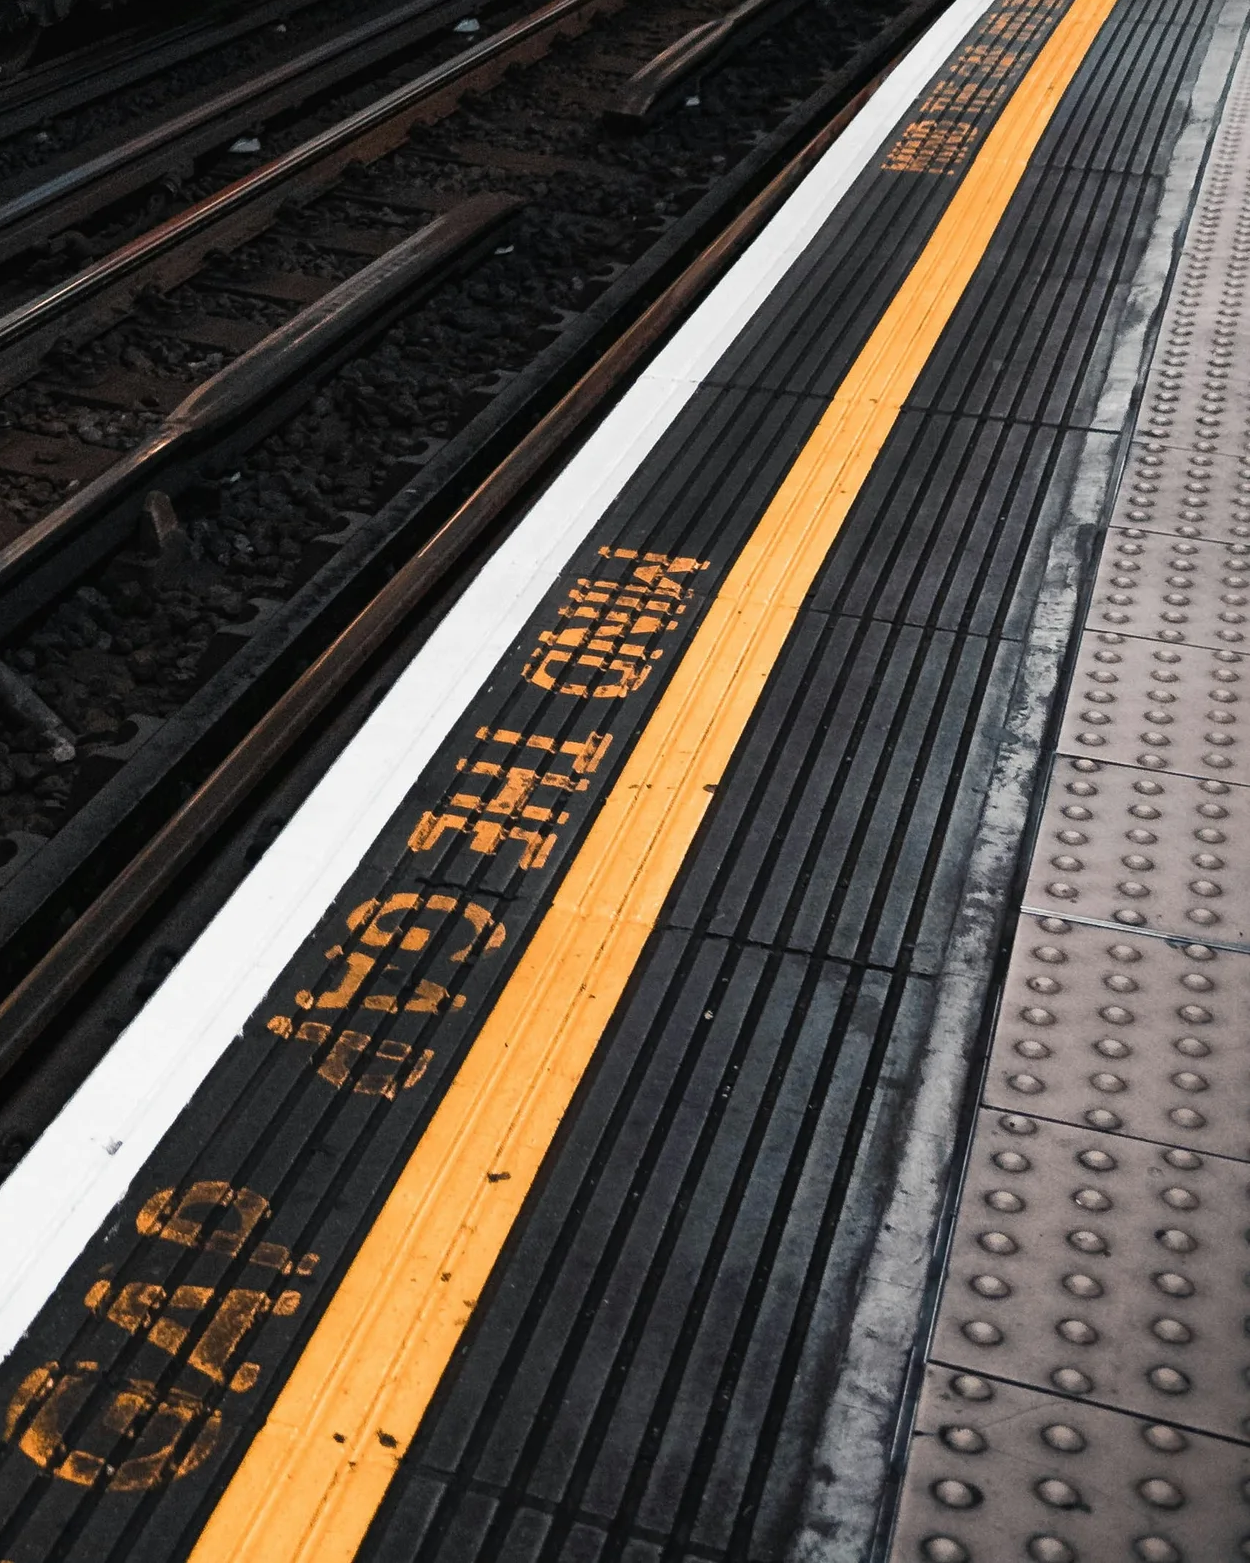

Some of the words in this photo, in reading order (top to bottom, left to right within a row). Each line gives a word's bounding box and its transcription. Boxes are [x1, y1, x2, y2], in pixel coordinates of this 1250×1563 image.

[520, 545, 711, 699] MIND
[406, 725, 614, 871] THE
[266, 891, 507, 1100] GAP
[5, 1180, 320, 1492] GAP
